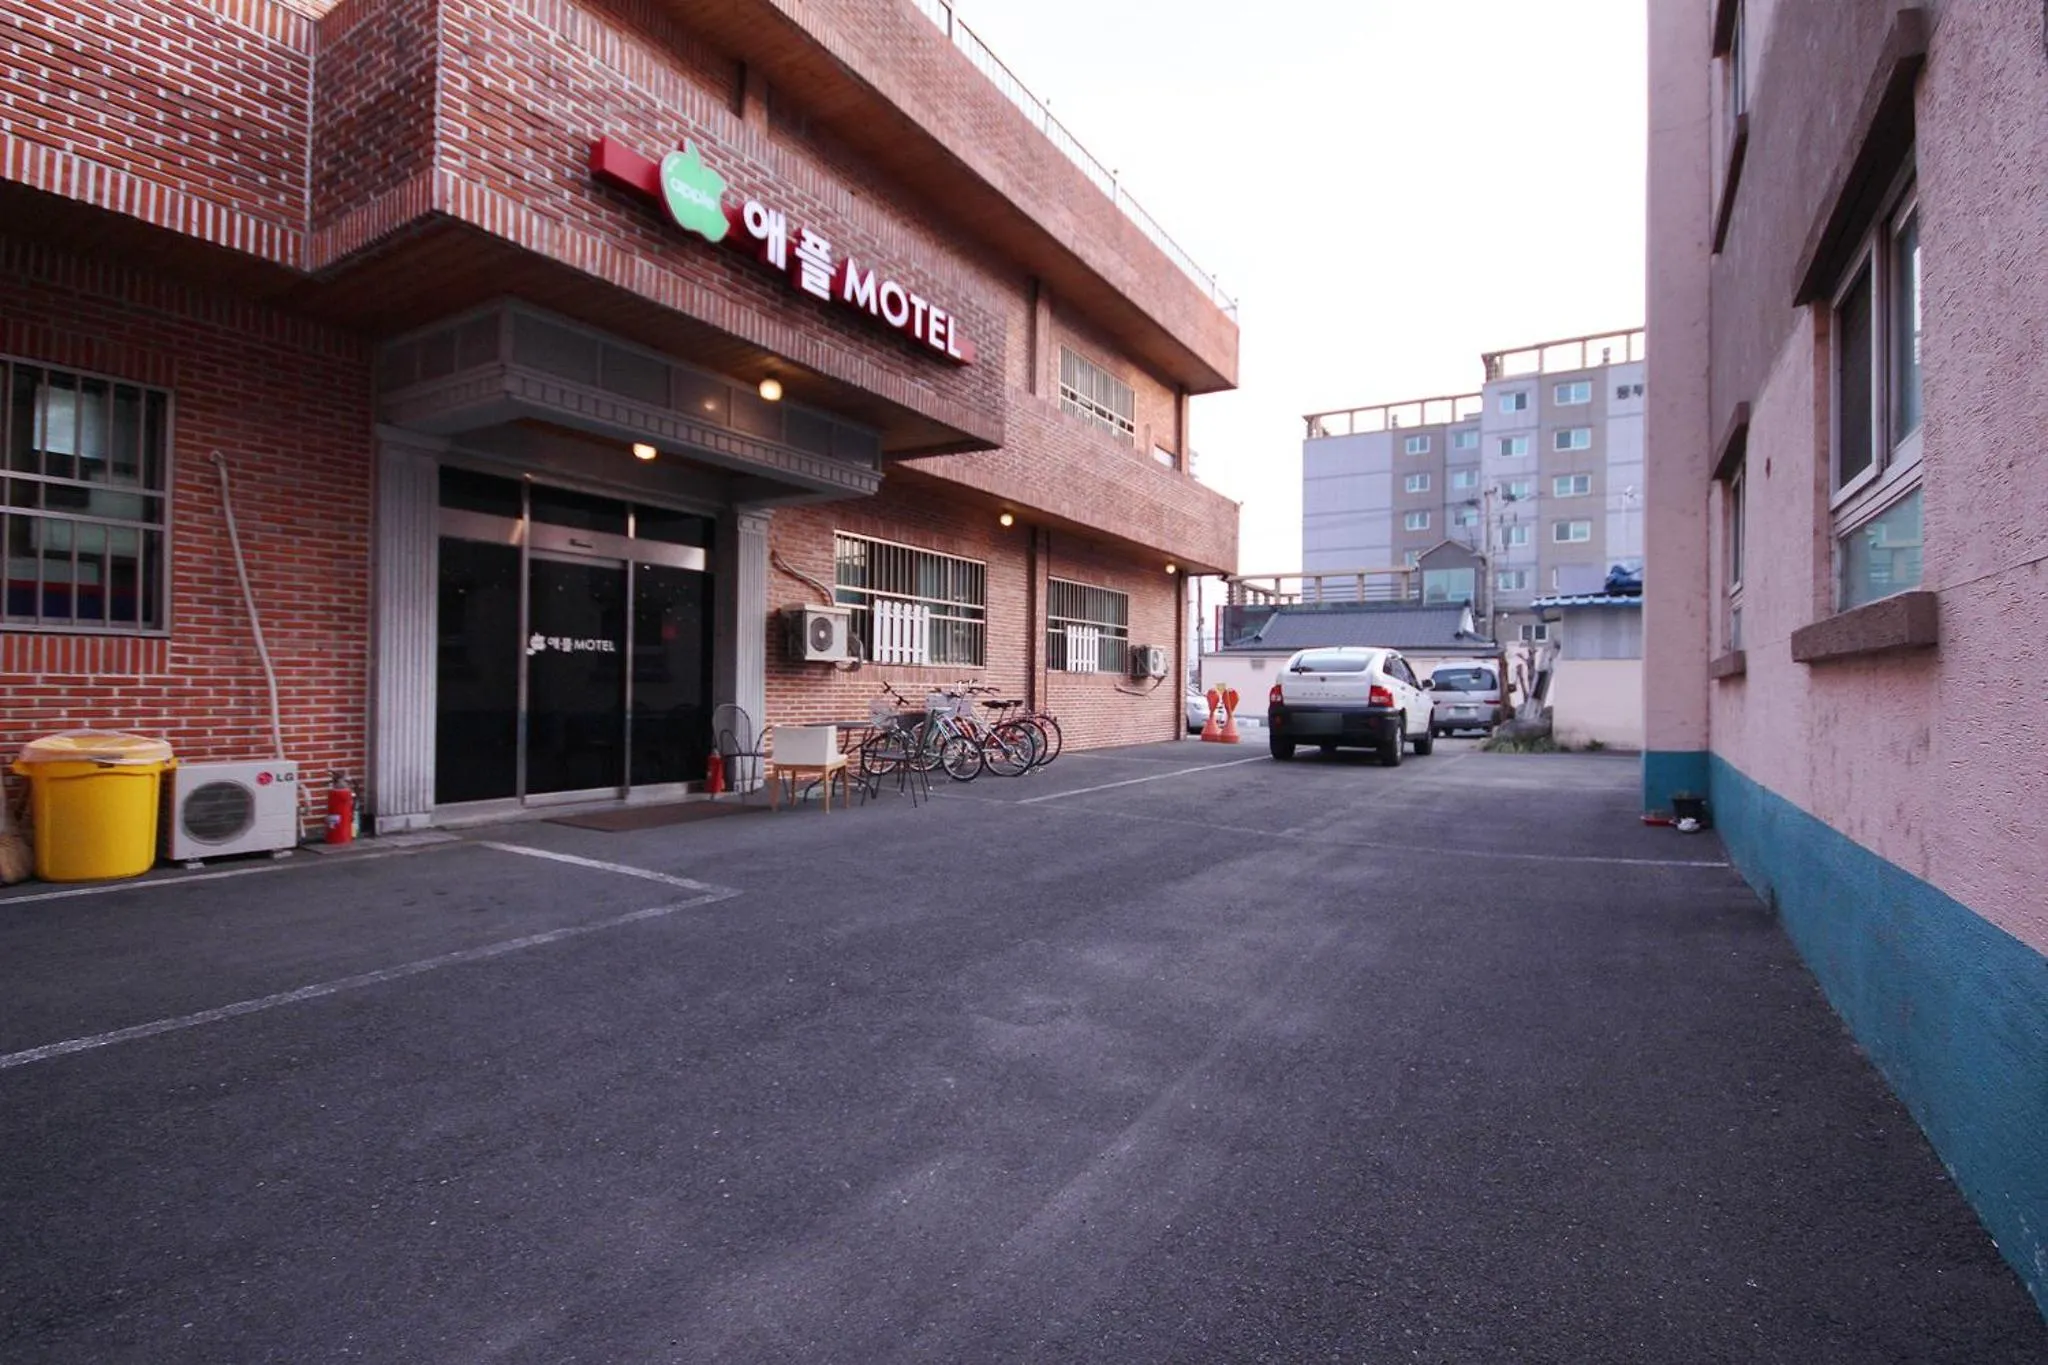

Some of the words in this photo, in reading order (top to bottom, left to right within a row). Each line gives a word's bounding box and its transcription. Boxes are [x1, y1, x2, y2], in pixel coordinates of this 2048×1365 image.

[743, 200, 836, 300] 애플
[843, 257, 962, 359] MOTEL
[574, 639, 615, 652] MOTEL
[276, 772, 294, 782] LG
